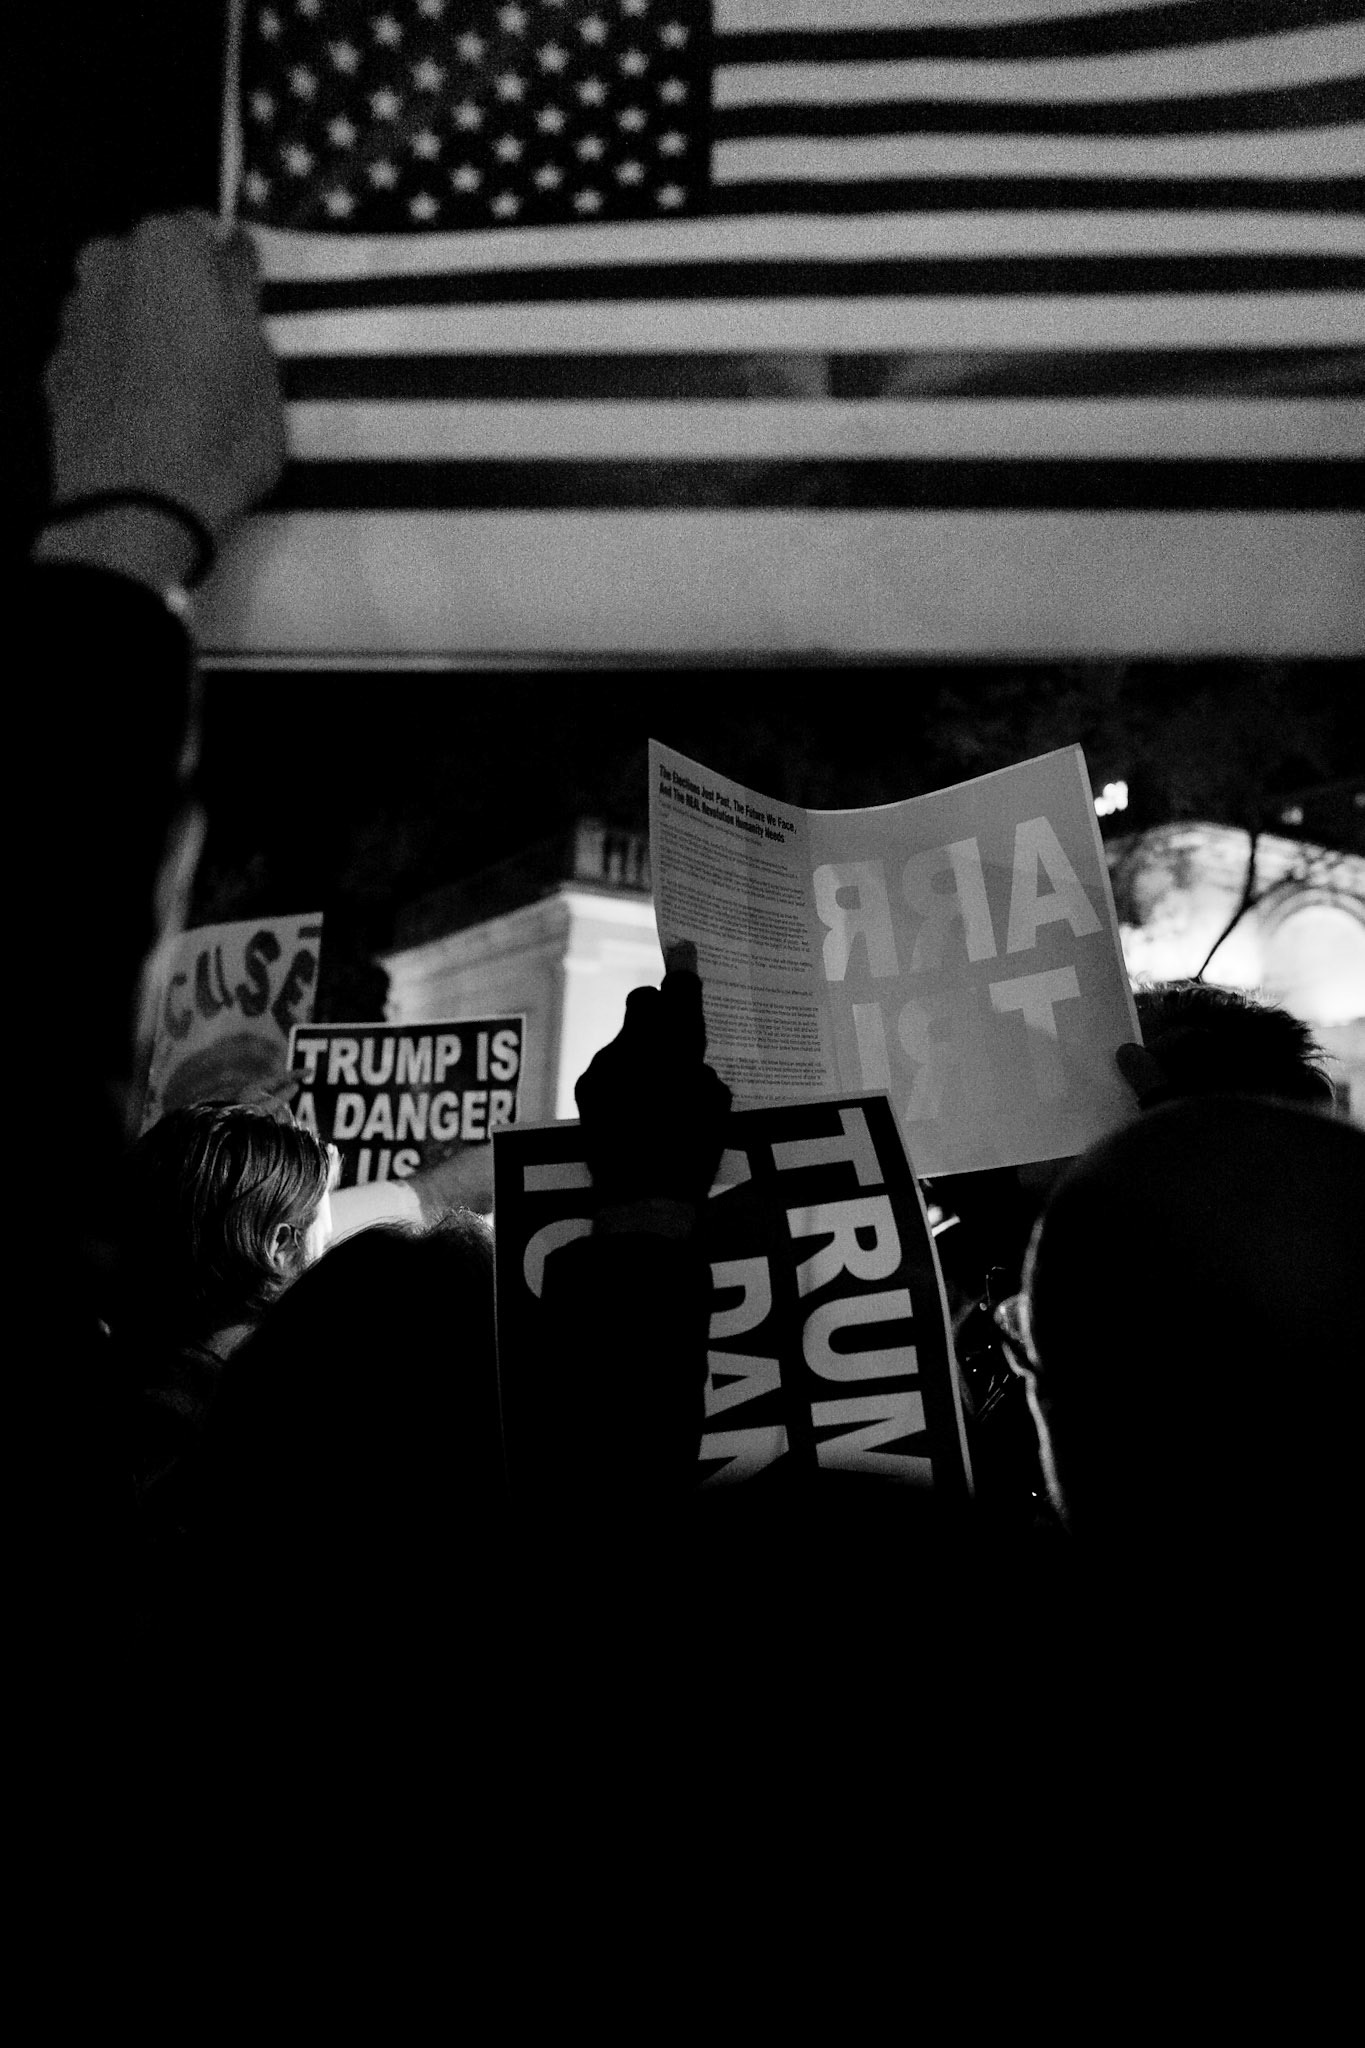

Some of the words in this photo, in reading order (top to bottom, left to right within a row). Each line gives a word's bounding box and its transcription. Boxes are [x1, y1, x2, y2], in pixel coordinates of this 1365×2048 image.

[659, 763, 672, 781] The
[702, 786, 714, 801] Just
[716, 792, 732, 810] Past,
[733, 799, 745, 815] The
[745, 804, 765, 822] Future
[766, 813, 777, 827] We
[778, 817, 797, 835] Face,
[659, 782, 672, 798] And
[673, 787, 685, 803] The
[702, 801, 734, 824] Revolution
[735, 815, 764, 839] Humanity
[765, 827, 785, 844] Needs
[299, 1033, 463, 1087] TRUMP
[475, 1029, 520, 1082] IS
[333, 1088, 517, 1143] DANGER
